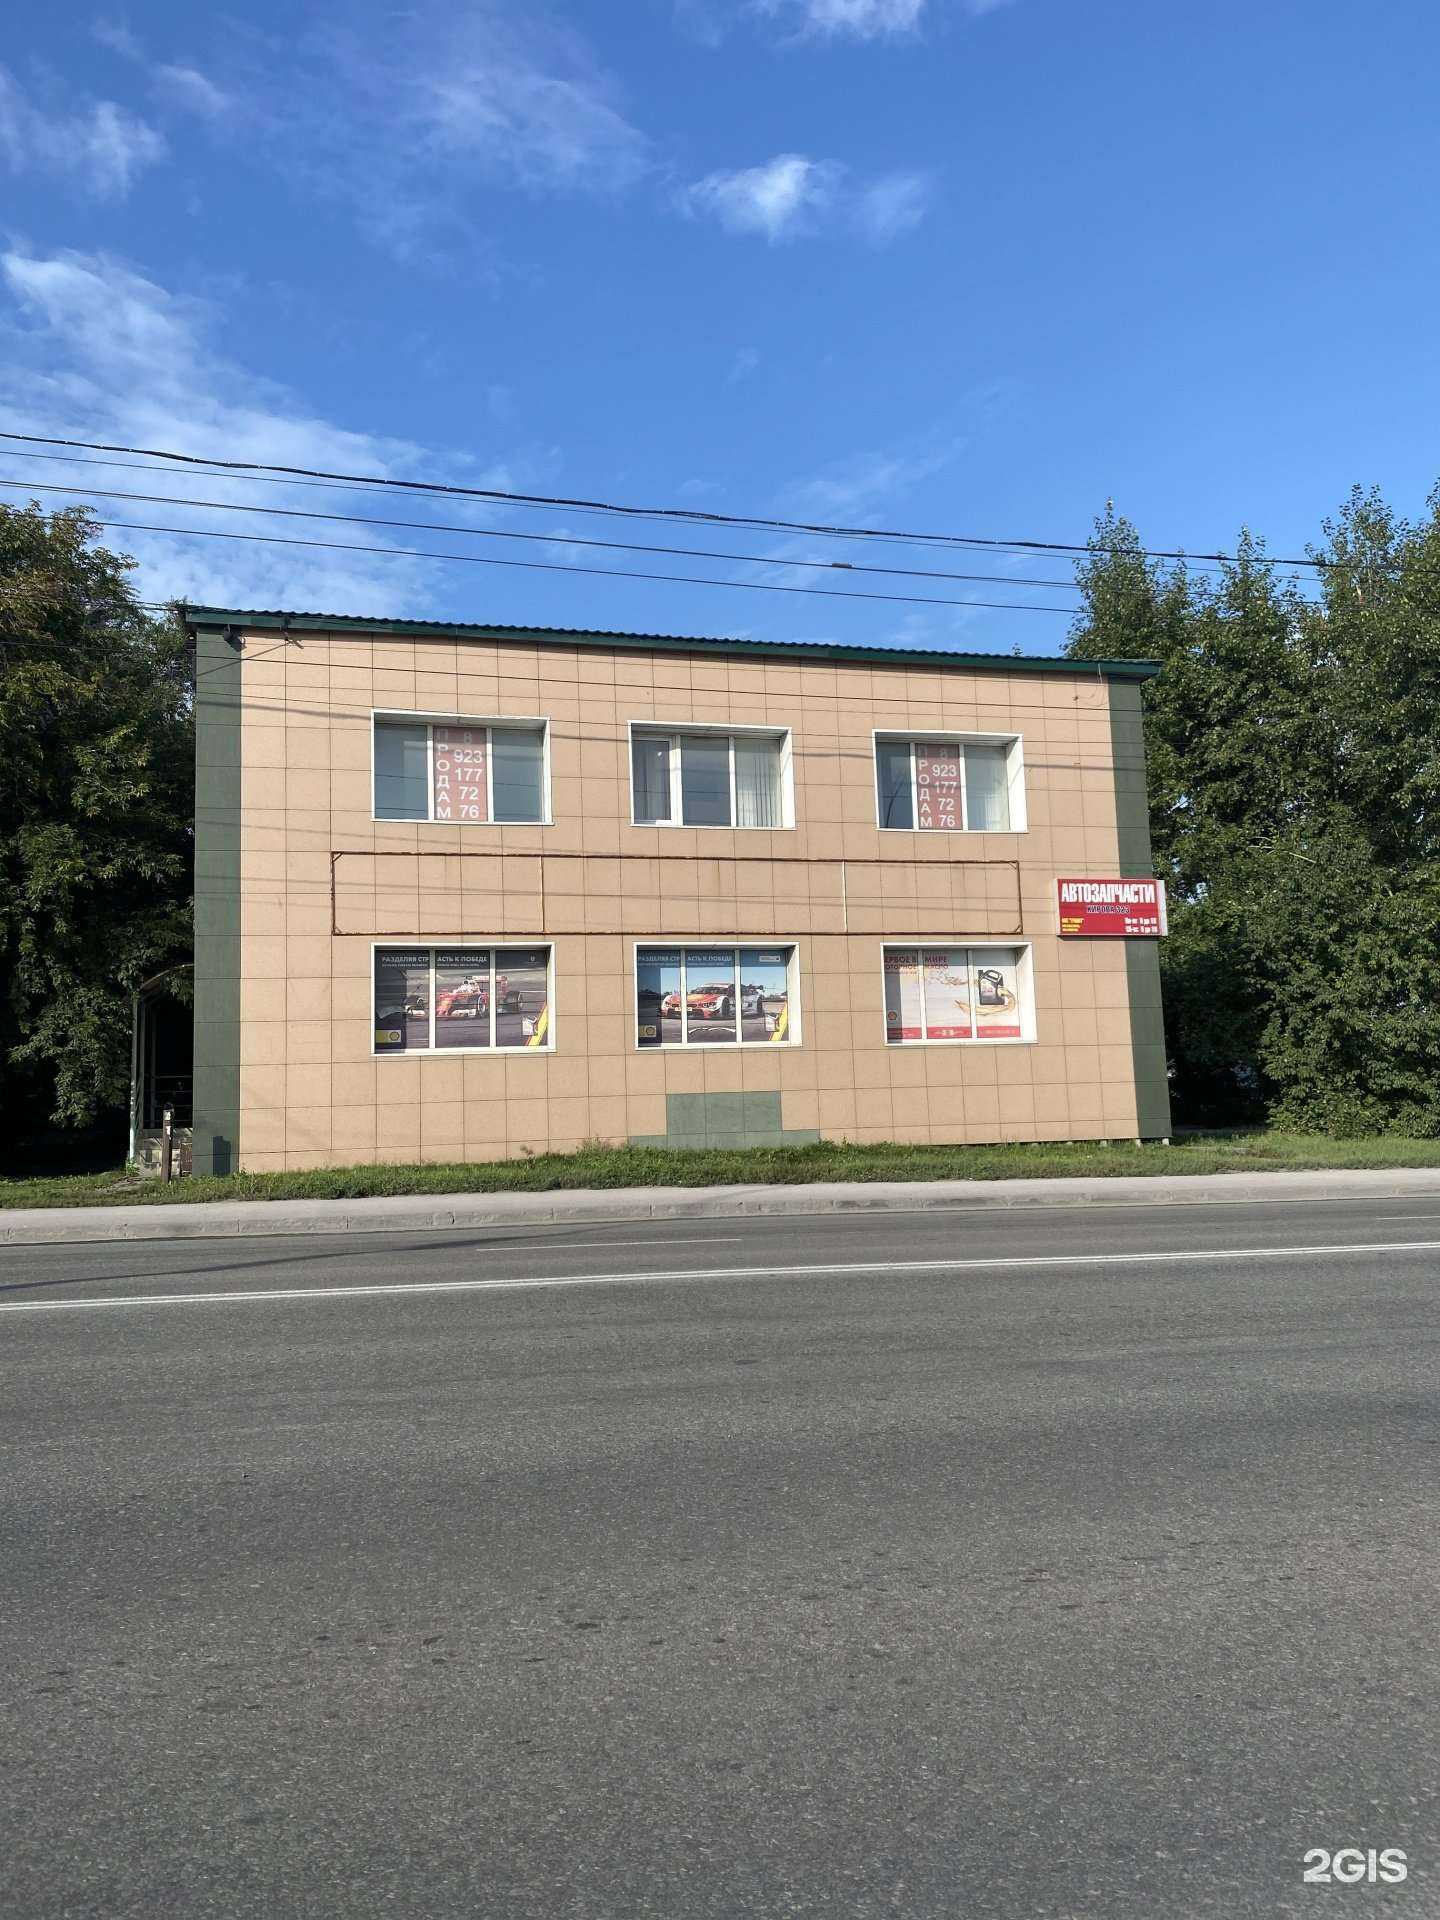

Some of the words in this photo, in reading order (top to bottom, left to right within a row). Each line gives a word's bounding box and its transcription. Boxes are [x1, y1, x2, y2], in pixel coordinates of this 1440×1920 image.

[454, 749, 483, 763] 923
[455, 768, 483, 782] 177
[932, 764, 957, 777] 923
[459, 786, 479, 800] 72
[934, 781, 957, 794] 177
[938, 798, 955, 811] 72
[459, 805, 480, 818] 76
[938, 814, 956, 827] 76
[1061, 883, 1155, 903] АВТОЗАПЧАСТИ
